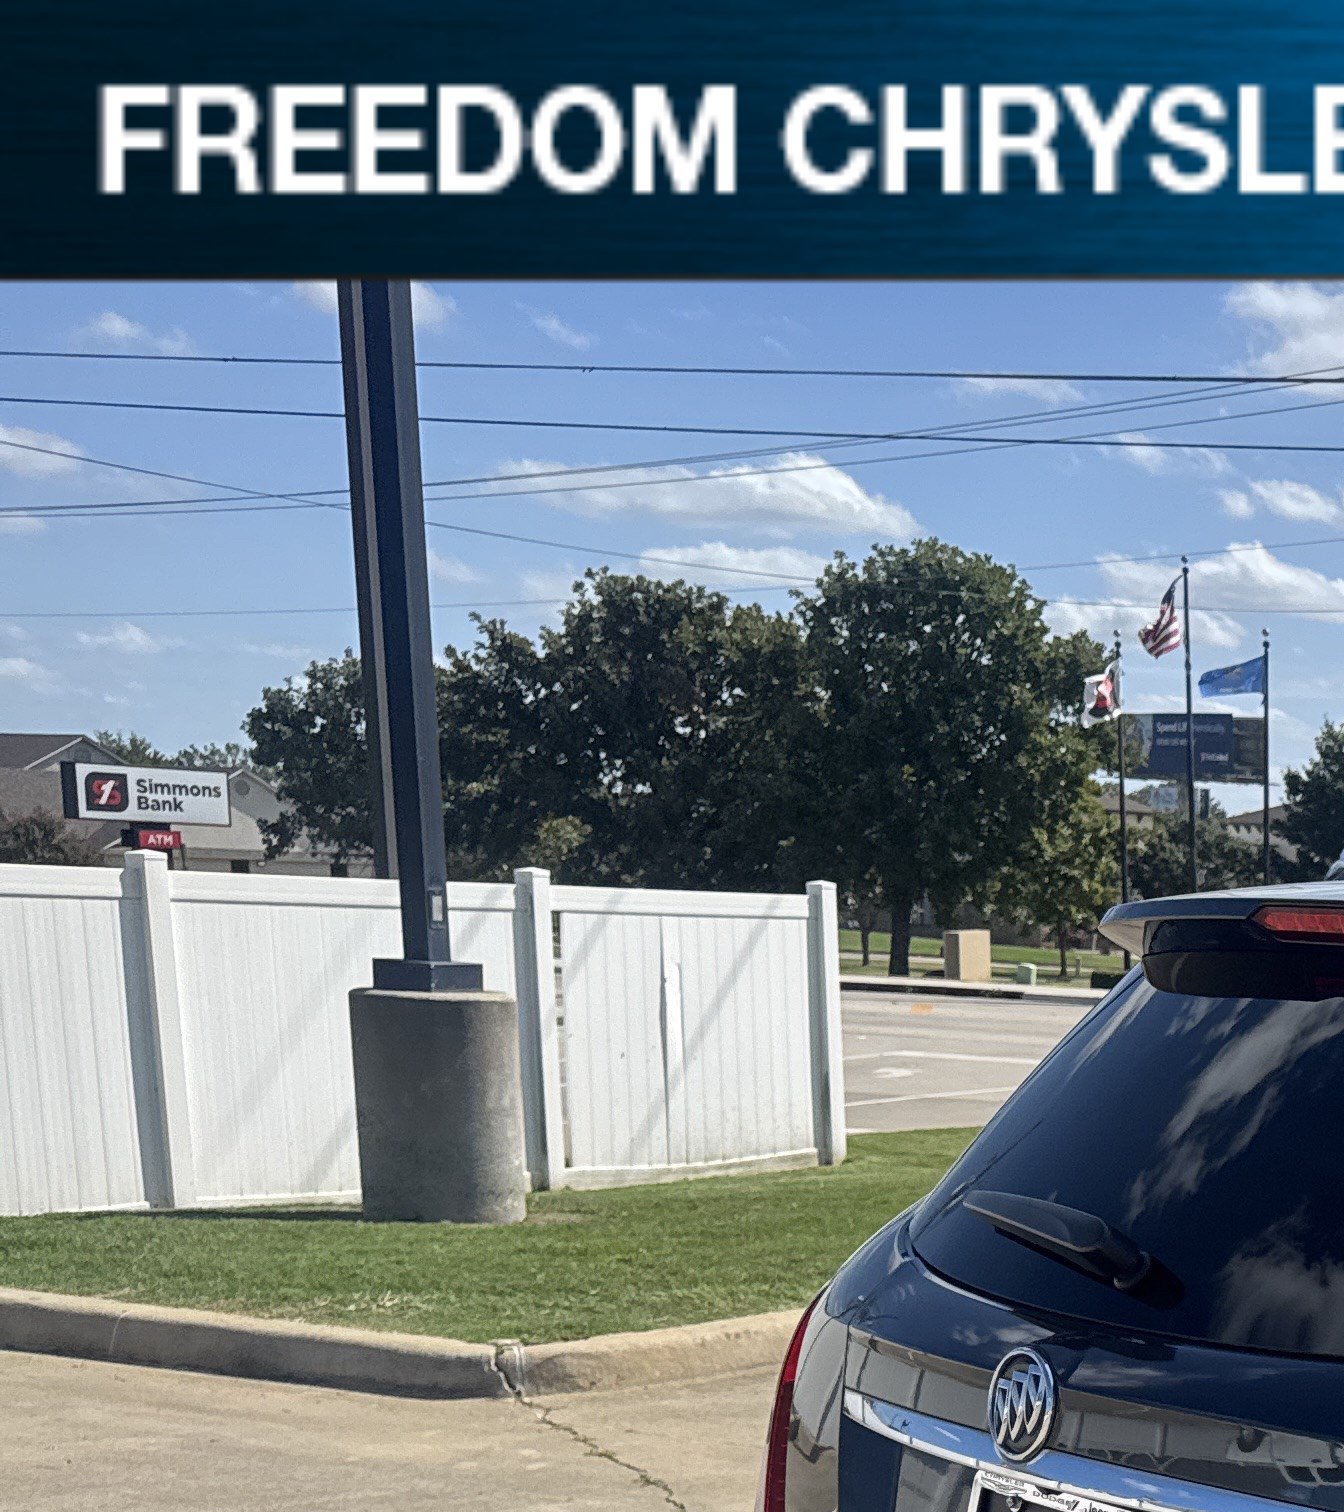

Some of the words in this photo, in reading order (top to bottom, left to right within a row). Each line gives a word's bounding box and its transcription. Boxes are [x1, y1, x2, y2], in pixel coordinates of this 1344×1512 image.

[136, 778, 222, 799] Simmons
[136, 795, 185, 813] Bank
[147, 835, 174, 846] ATM
